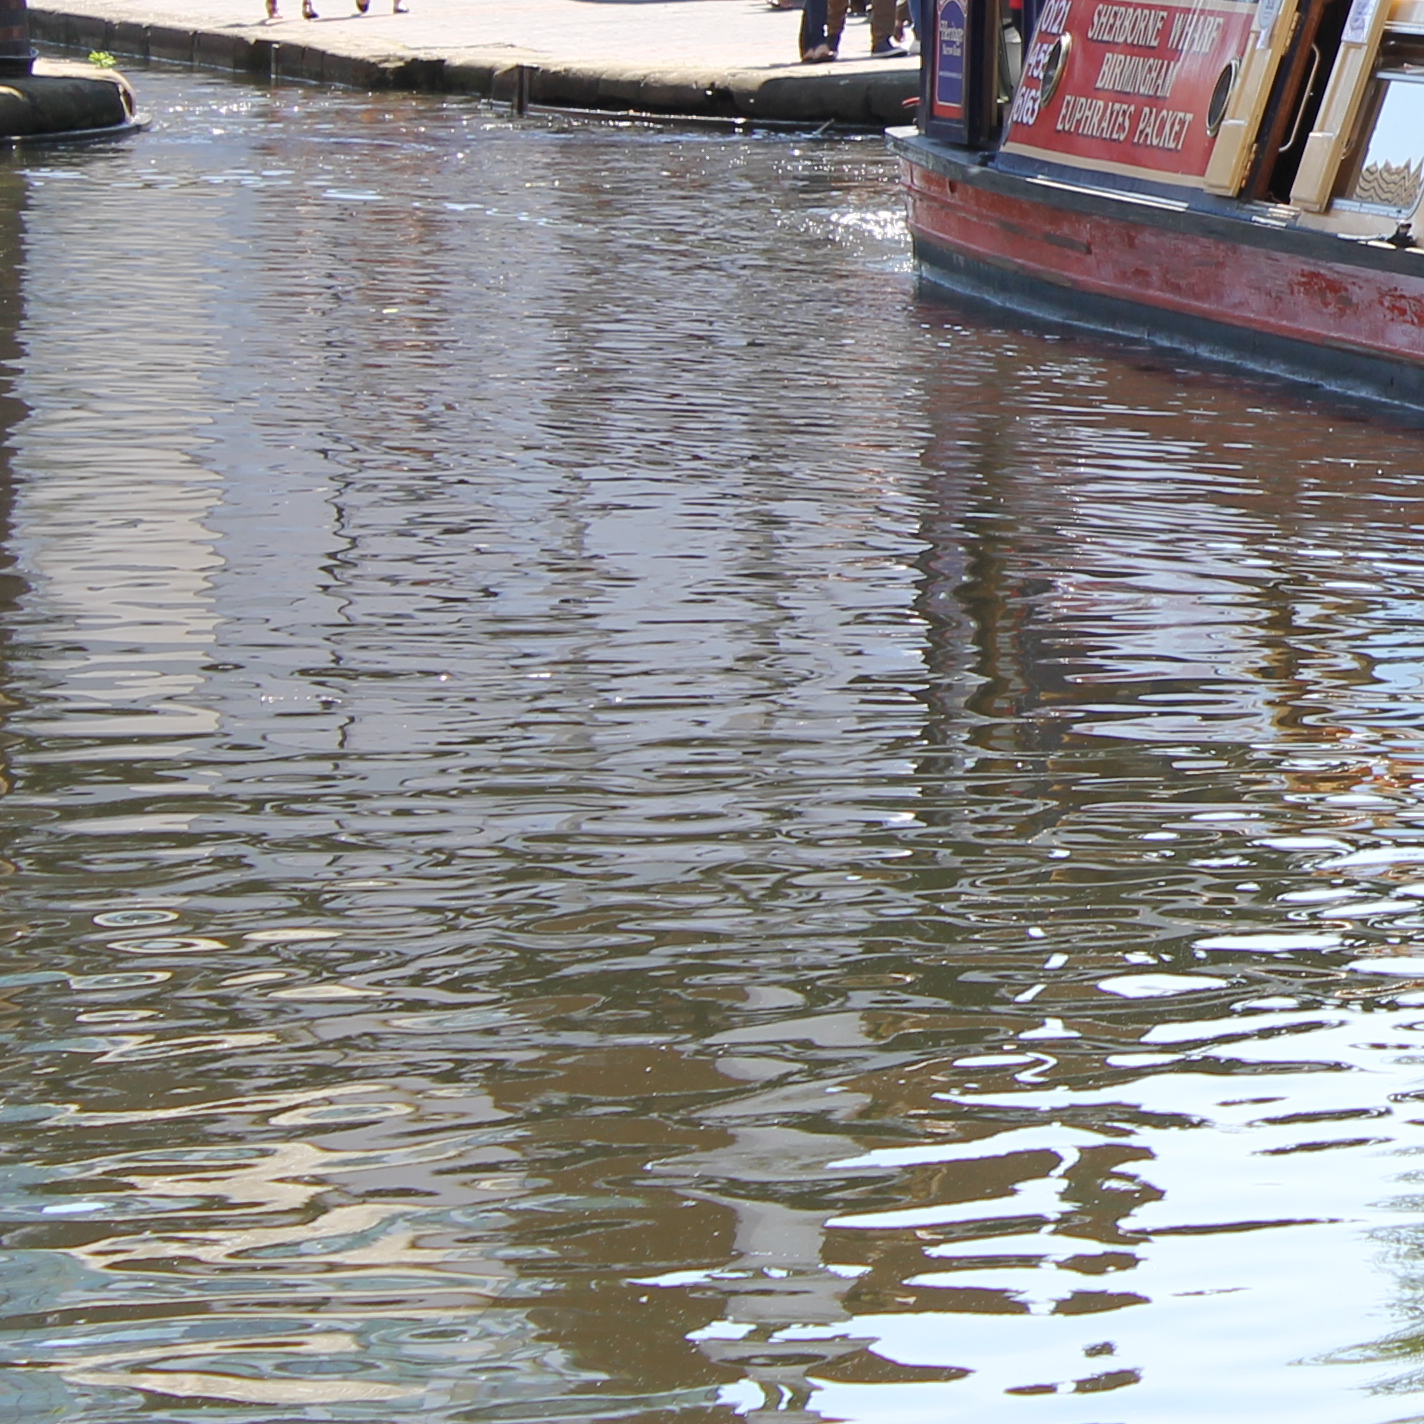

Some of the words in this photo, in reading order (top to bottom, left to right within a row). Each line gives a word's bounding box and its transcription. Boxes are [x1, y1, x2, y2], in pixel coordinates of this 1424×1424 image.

[1087, 3, 1168, 48] SHERBORNE
[1167, 12, 1225, 54] WHARF
[1095, 51, 1181, 98] BIRMINGHAM
[1056, 94, 1136, 141] EUPHRATES
[1132, 106, 1194, 151] PACKET
